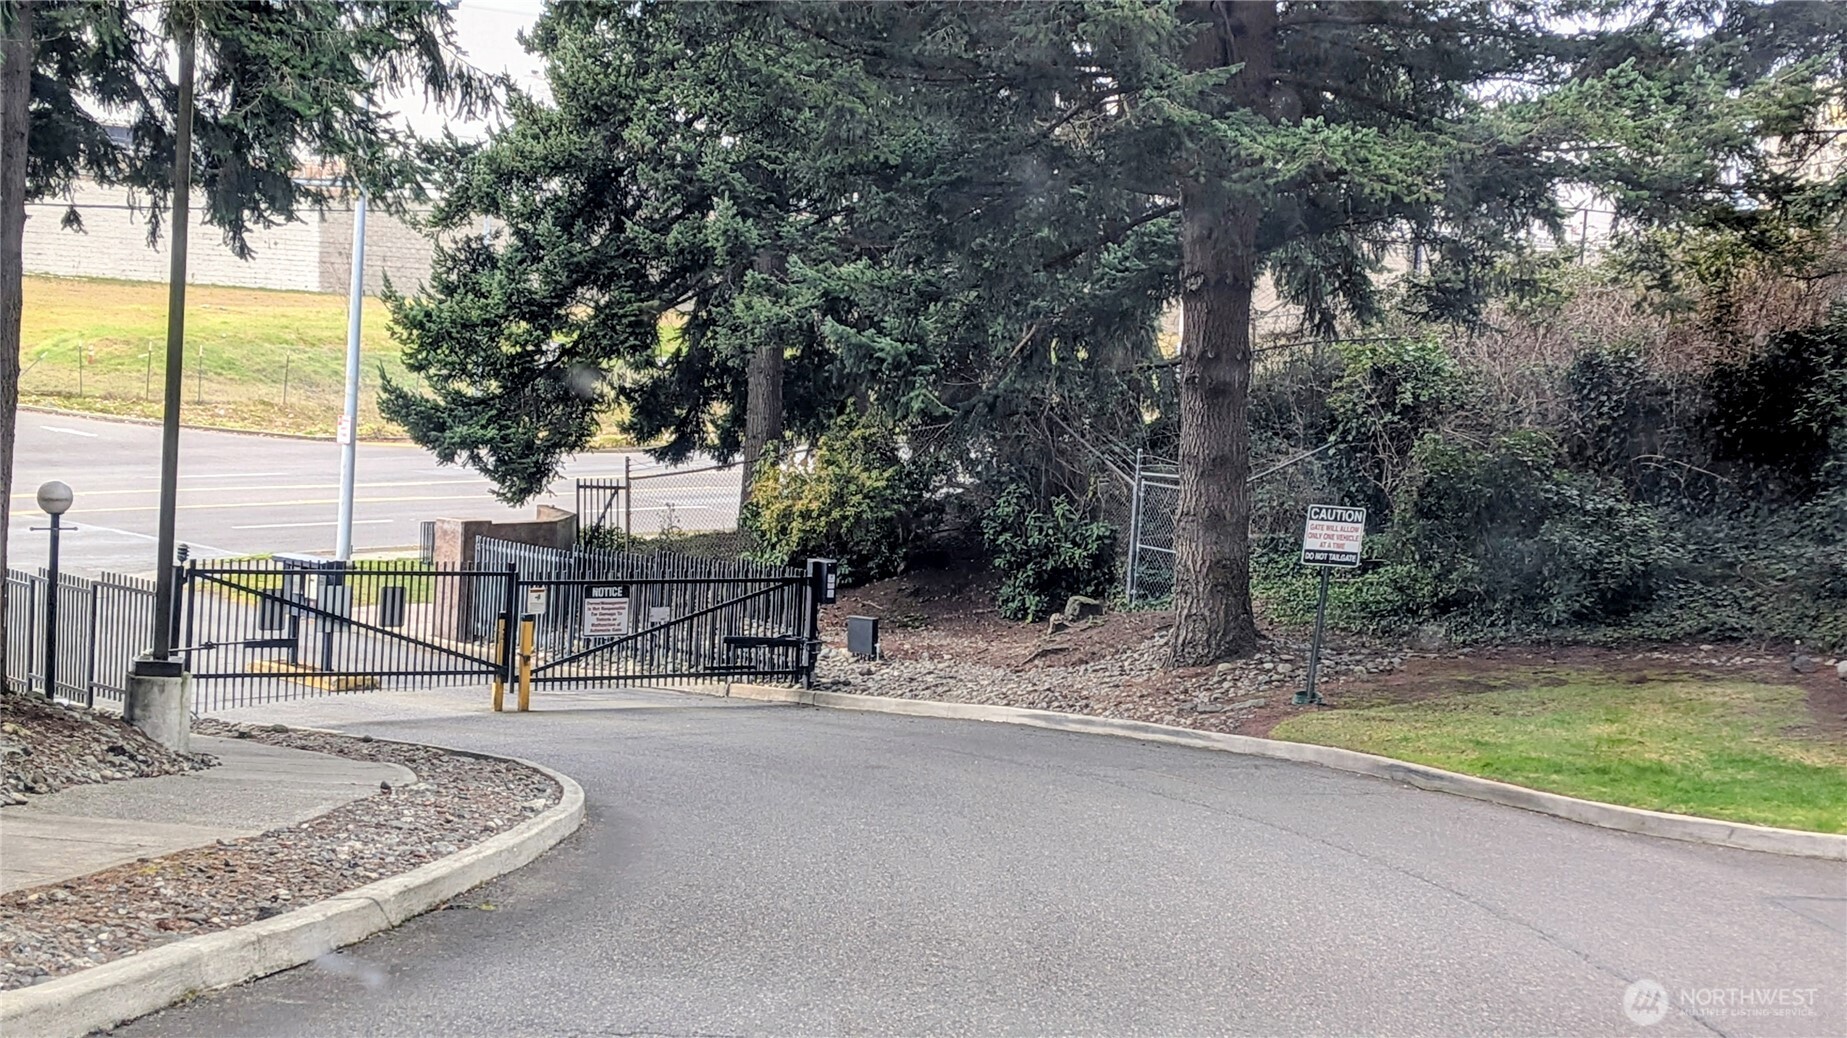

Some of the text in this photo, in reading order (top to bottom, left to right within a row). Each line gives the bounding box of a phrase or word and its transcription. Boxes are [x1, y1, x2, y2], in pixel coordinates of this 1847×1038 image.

[1311, 508, 1363, 522] CAUTION
[1326, 524, 1339, 532] WILL
[1305, 552, 1357, 562] DO NOT TAILGATE
[592, 586, 623, 597] NOTICE
